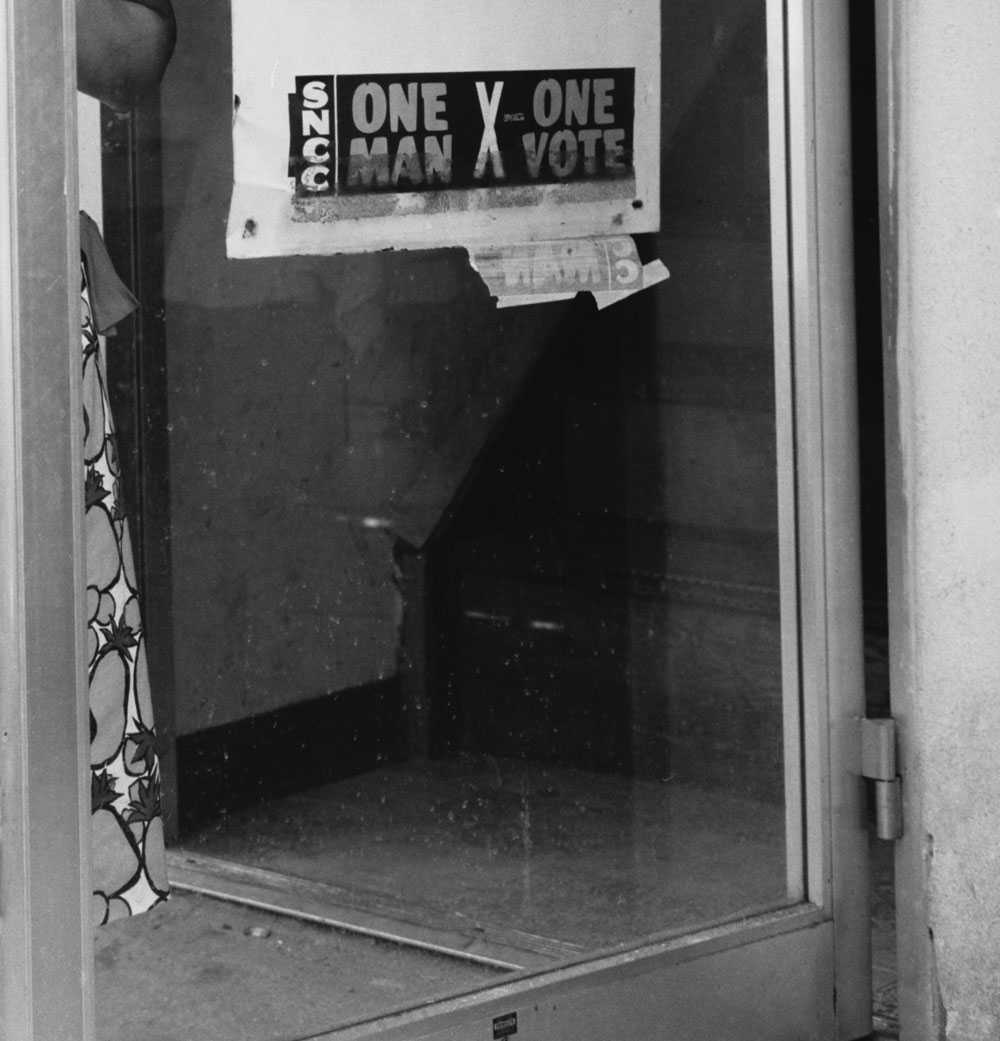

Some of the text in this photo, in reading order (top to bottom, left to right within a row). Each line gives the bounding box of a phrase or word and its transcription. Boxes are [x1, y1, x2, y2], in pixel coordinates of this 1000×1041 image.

[352, 81, 448, 133] ONE
[533, 77, 615, 127] ONE
[301, 80, 330, 192] SNCC
[348, 128, 626, 187] MAN VOTE
